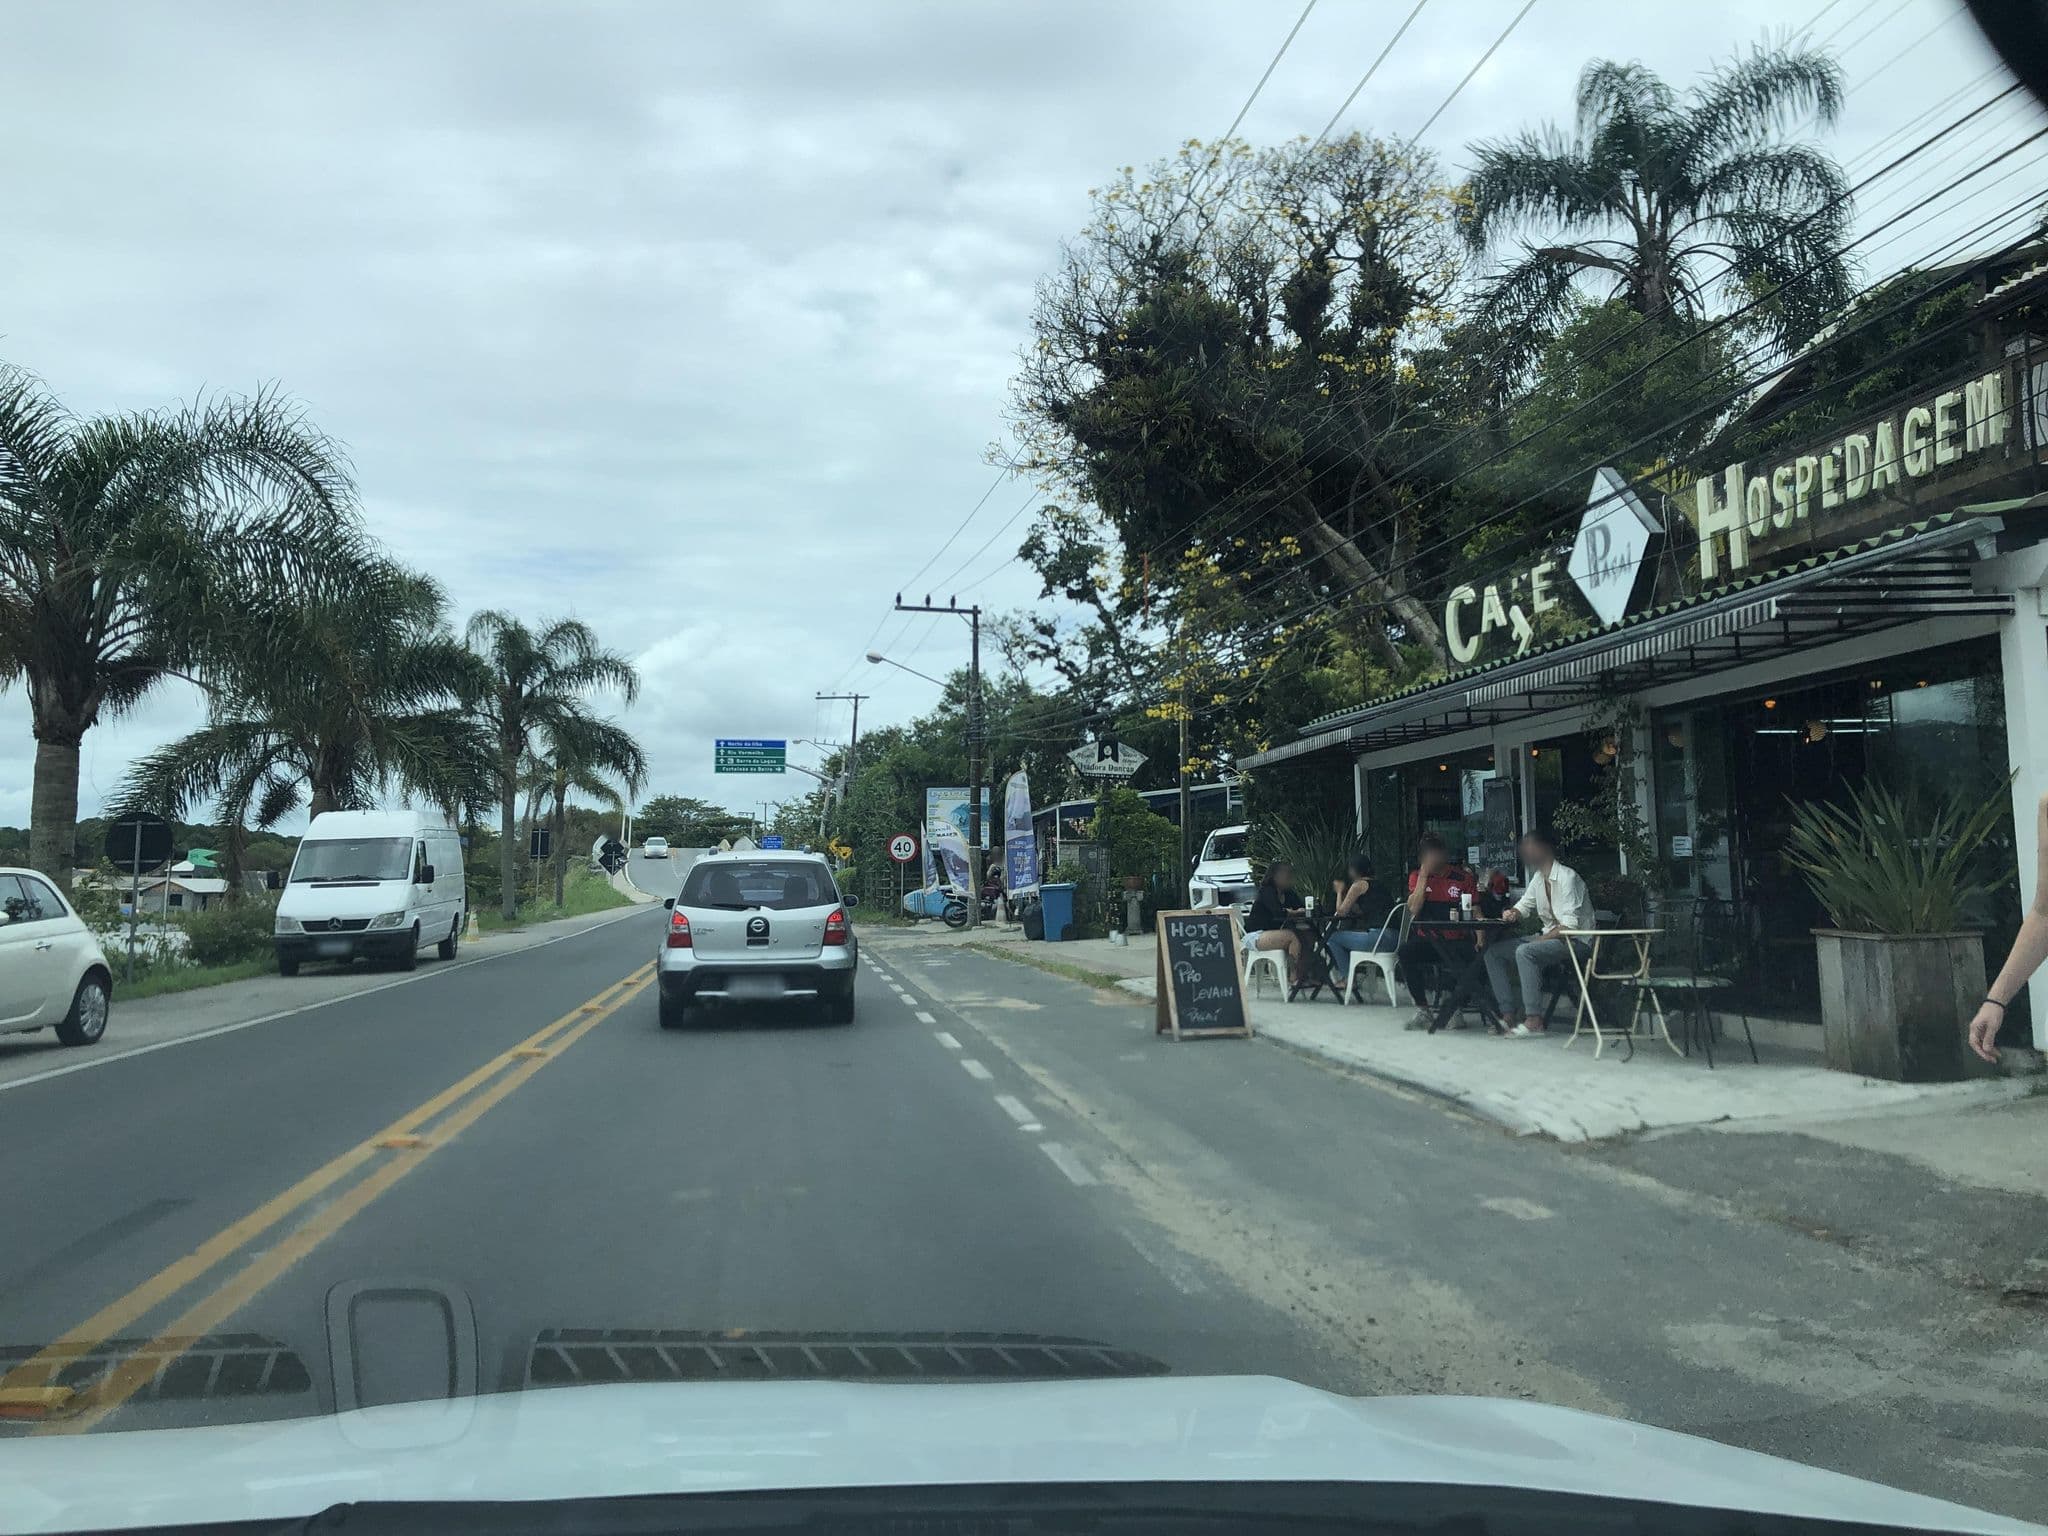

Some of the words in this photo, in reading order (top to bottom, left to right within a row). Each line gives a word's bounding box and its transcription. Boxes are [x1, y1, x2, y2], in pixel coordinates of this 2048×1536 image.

[1696, 372, 2005, 580] HOSPEDAGEM
[893, 841, 912, 853] 40
[1171, 922, 1219, 939] HOJE
[1182, 940, 1225, 958] TEM
